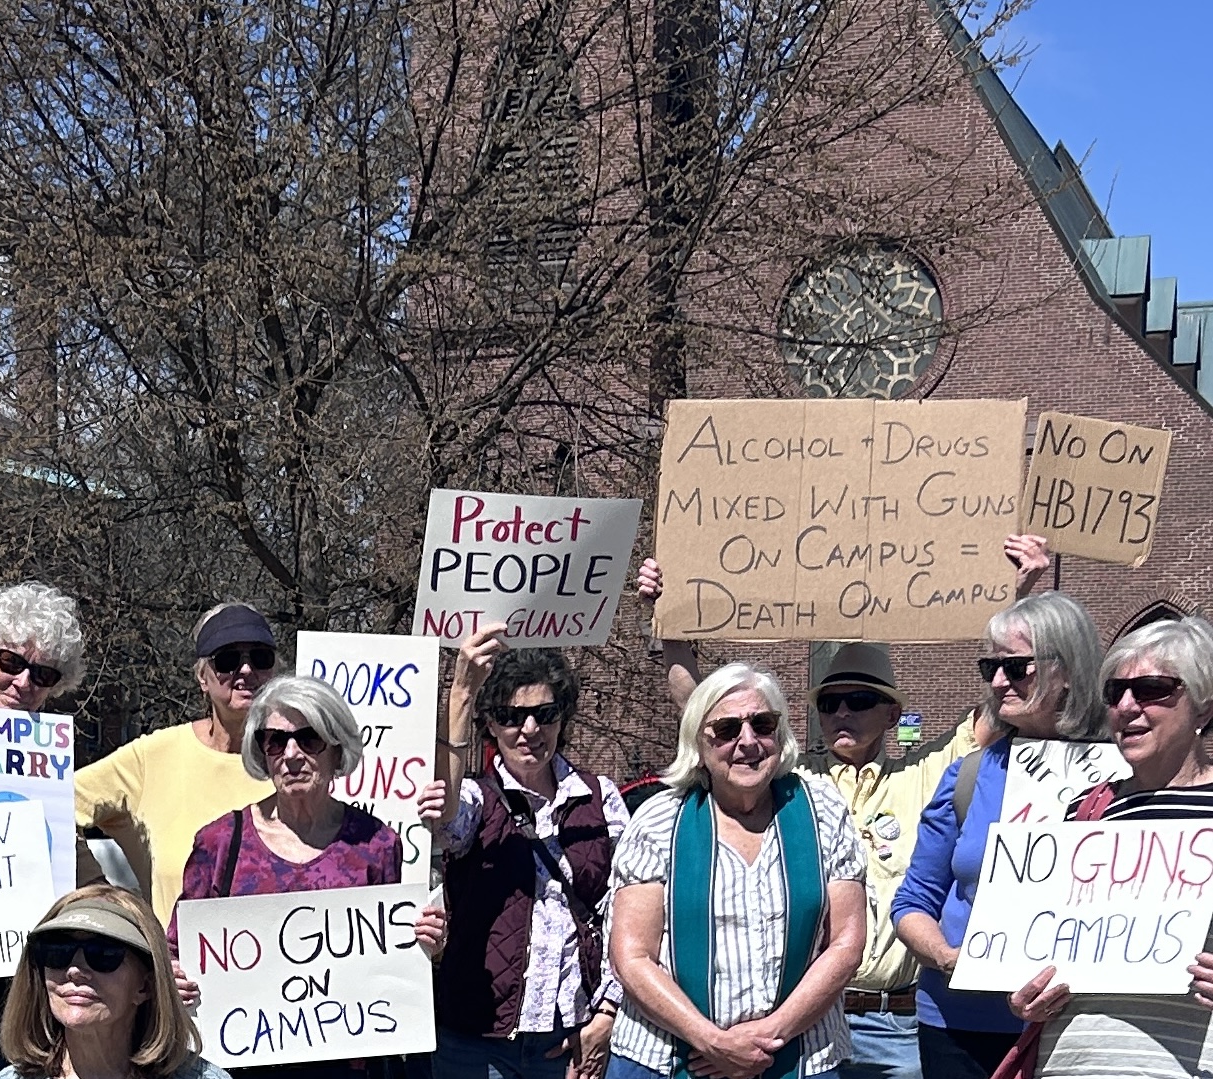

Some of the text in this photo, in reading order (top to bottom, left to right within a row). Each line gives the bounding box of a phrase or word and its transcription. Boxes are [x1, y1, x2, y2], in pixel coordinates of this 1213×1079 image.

[676, 415, 844, 466] ALCOHOL
[880, 420, 991, 466] DRUGS
[451, 495, 592, 545] Protect
[662, 470, 1018, 526] MIXED WITH GUNS
[1028, 475, 1157, 545] HB1793
[430, 547, 614, 597] PEOPLE
[794, 524, 936, 574] CAMPUS
[422, 607, 486, 640] NOT
[681, 570, 1010, 634] DEATH ON CAMPUS
[361, 724, 394, 749] OT
[328, 755, 427, 801] UNS
[988, 827, 1213, 890] NO GUNS
[198, 900, 419, 976] NO GUNS
[966, 909, 1192, 965] on CAMPUS
[281, 968, 332, 1003] ON
[219, 999, 399, 1057] CAMPUS
